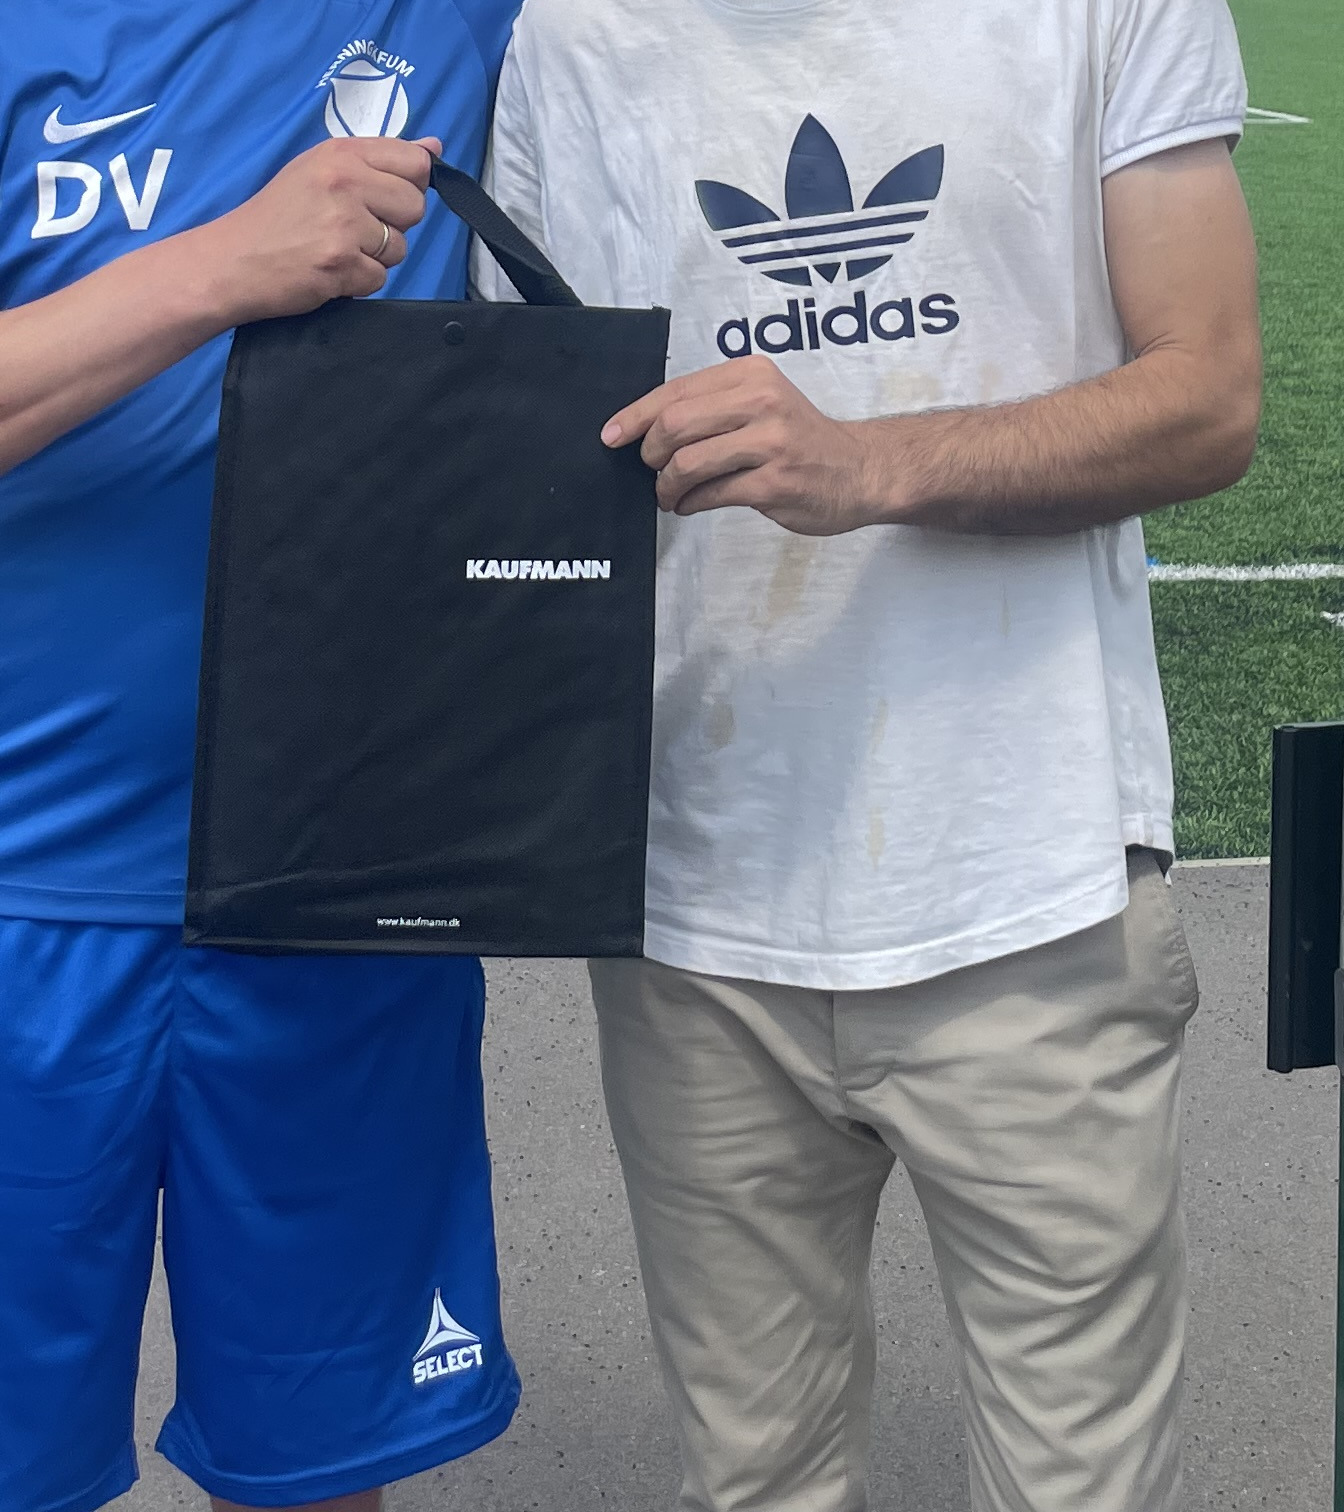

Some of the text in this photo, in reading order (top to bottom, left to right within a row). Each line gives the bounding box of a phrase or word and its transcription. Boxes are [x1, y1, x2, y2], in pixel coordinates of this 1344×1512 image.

[31, 148, 174, 240] DV
[716, 290, 960, 359] adidas
[466, 559, 611, 580] KAUFMANN
[376, 916, 461, 927] www.kaufmann.dk
[412, 1343, 483, 1384] SELECT
